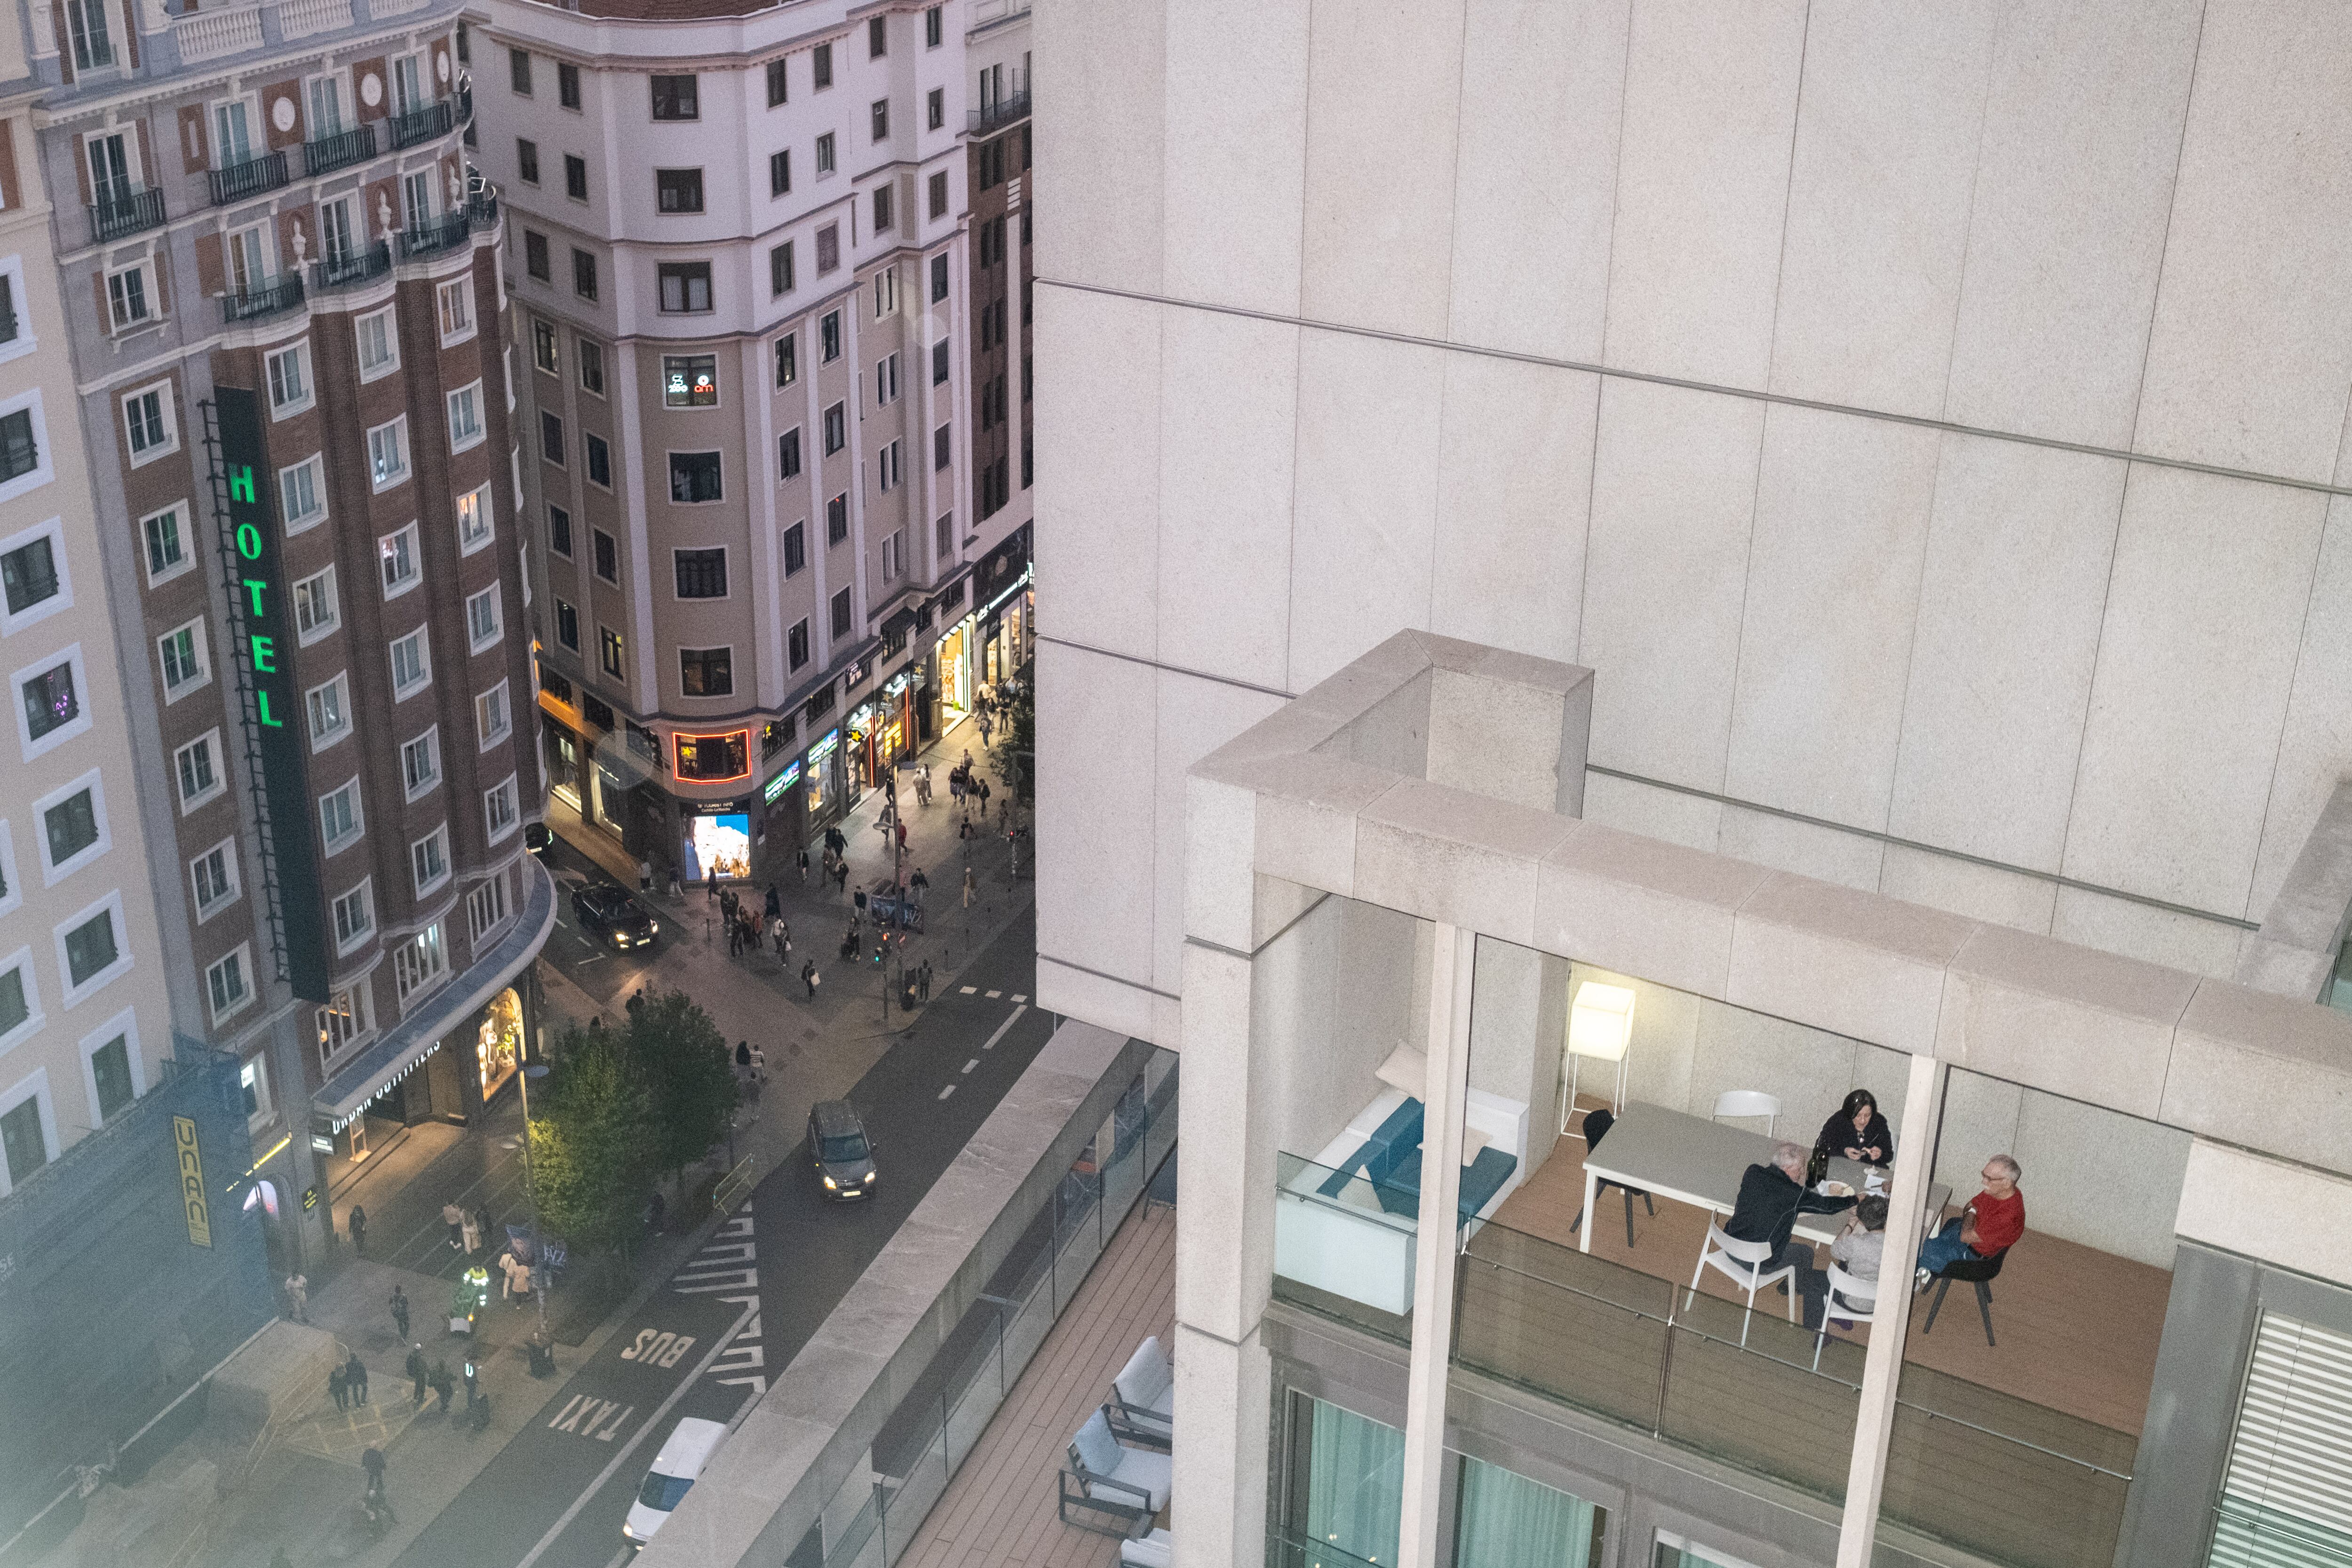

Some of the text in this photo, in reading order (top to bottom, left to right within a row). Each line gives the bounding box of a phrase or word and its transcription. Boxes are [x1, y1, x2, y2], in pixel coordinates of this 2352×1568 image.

[229, 464, 282, 727] HOTEL
[620, 1328, 696, 1369] BUS
[548, 1394, 634, 1442] TAXI
